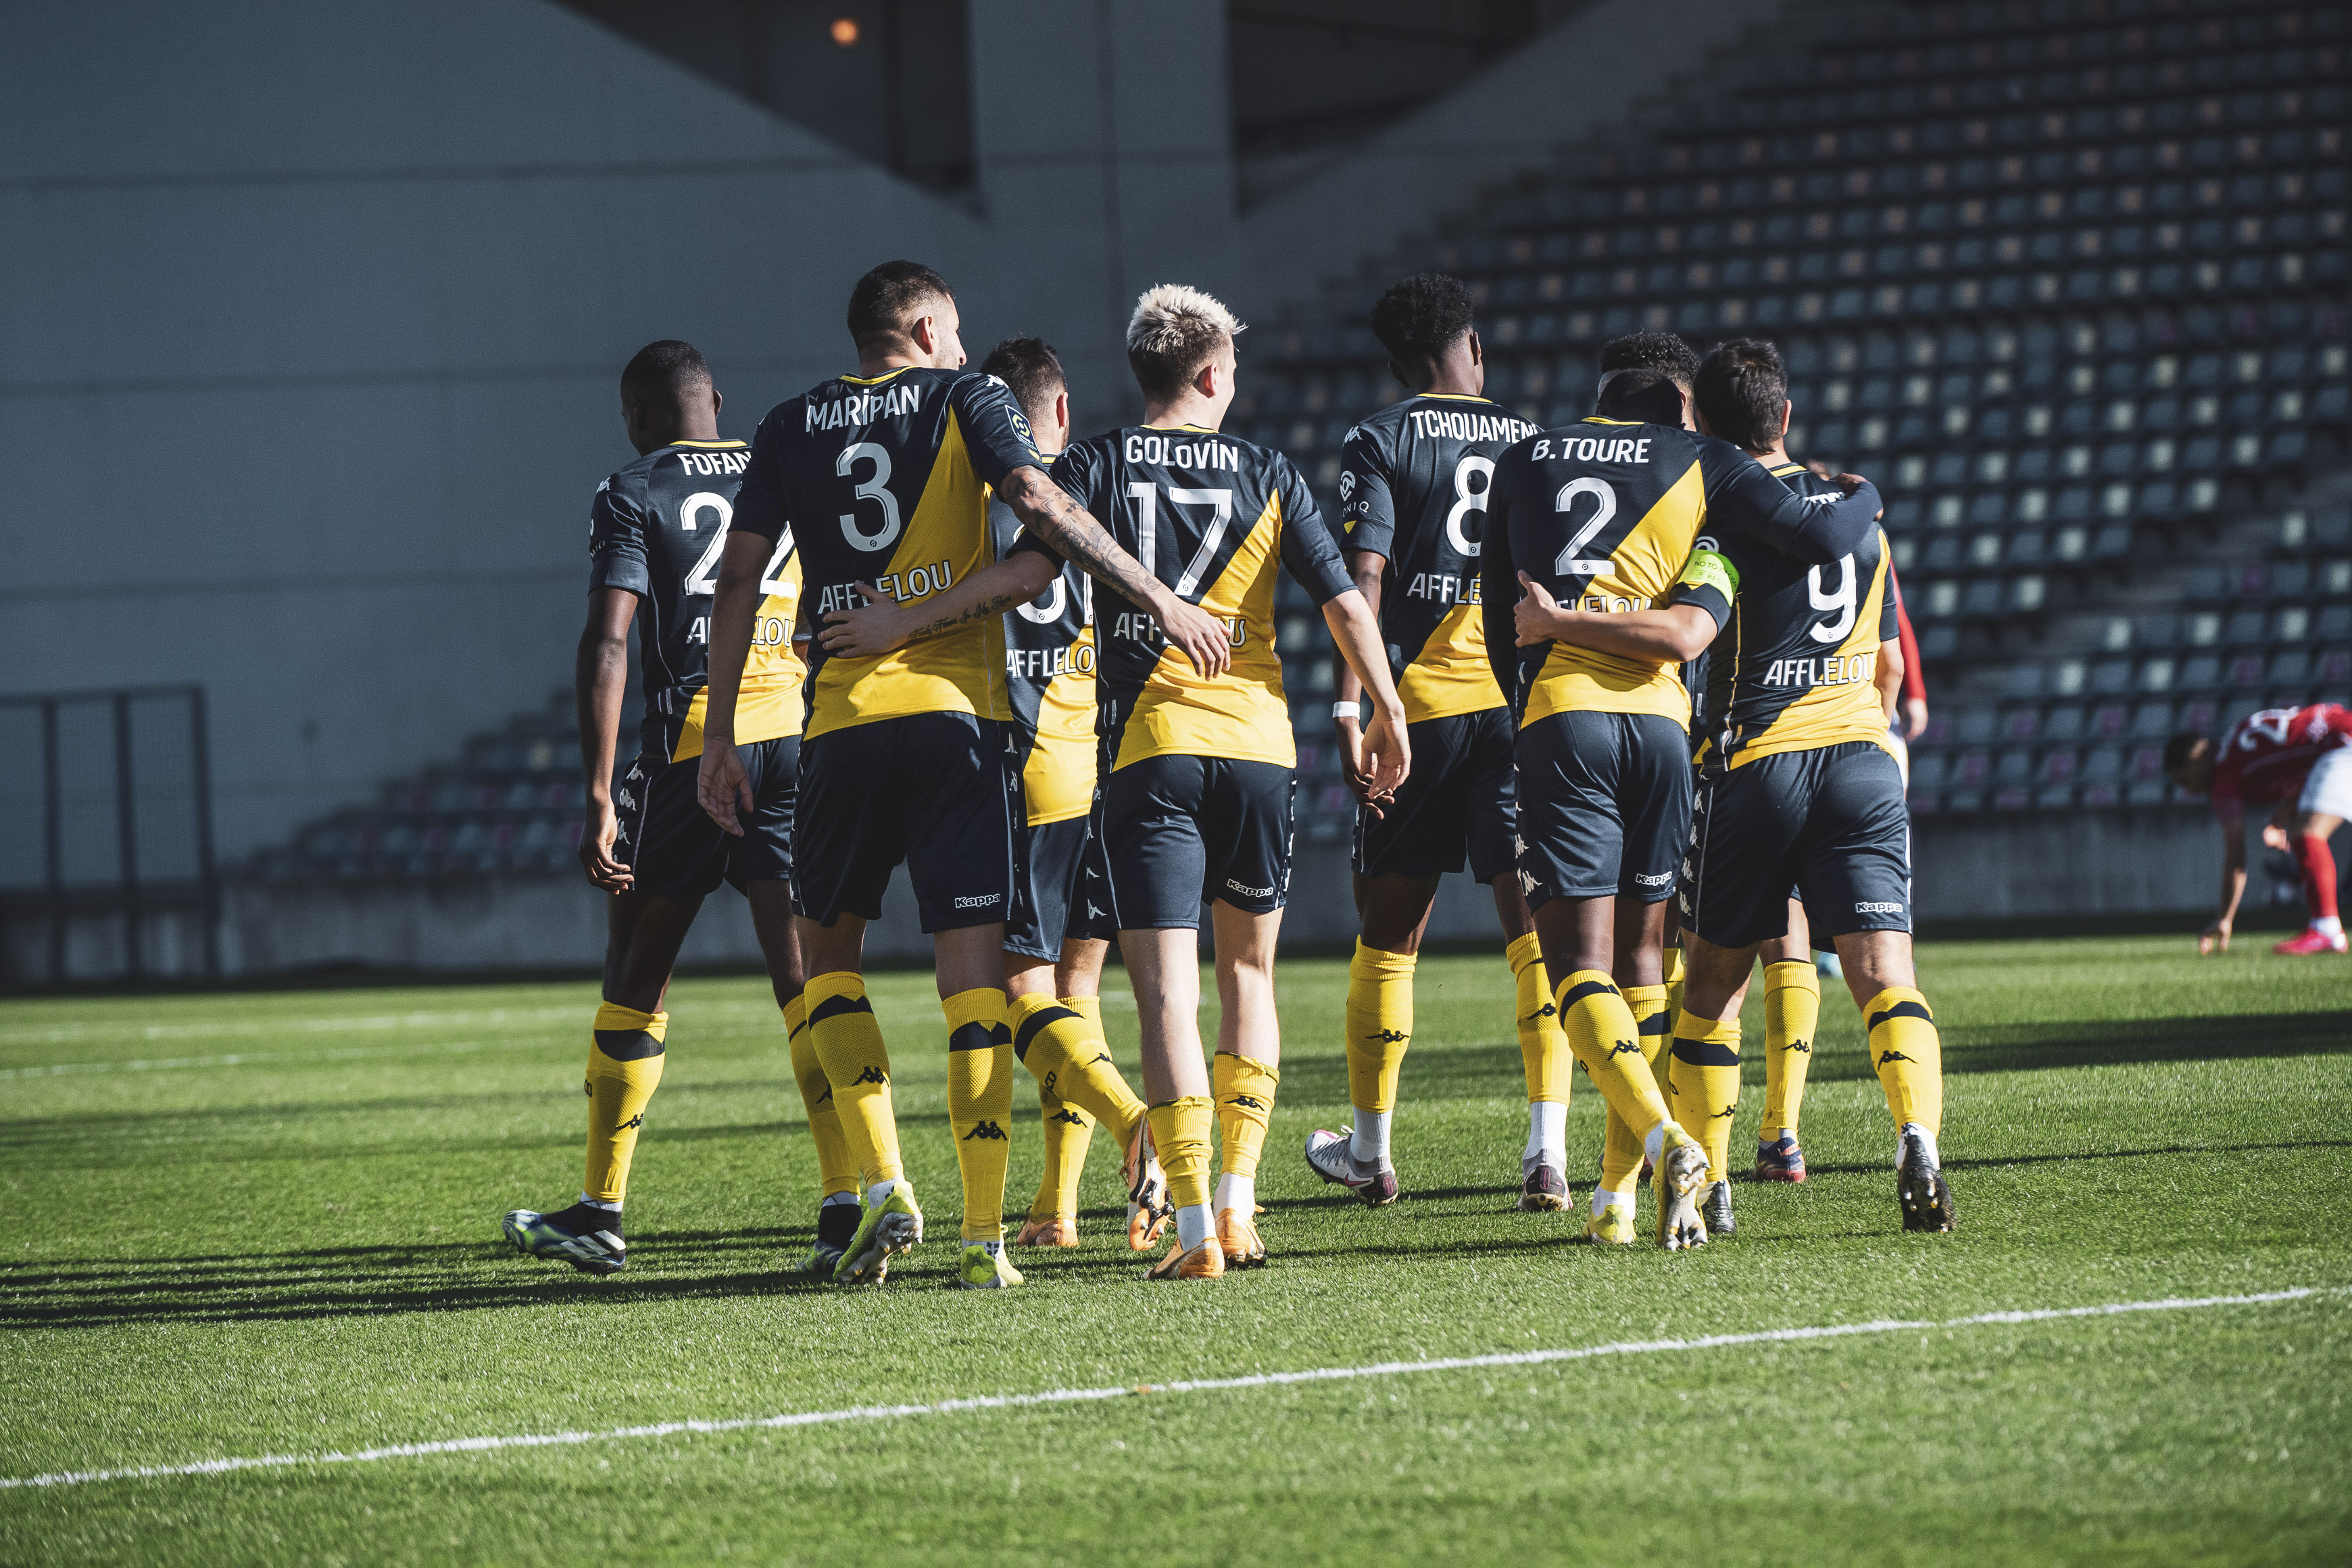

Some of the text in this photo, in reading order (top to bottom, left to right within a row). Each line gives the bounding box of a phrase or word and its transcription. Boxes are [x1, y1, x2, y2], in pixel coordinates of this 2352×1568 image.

[1125, 435, 1238, 472] GOLOVIN
[1562, 437, 1652, 464] TOURE
[835, 442, 901, 552] 3
[1446, 456, 1496, 557] 8
[1126, 482, 1233, 596] 17
[1555, 476, 1617, 576] 2
[1406, 572, 1482, 605] AFFLE
[1808, 552, 1857, 643] 9
[1763, 652, 1877, 687] AFFLELOU
[1227, 879, 1273, 898] Kappa
[1636, 871, 1673, 886] Kappa
[955, 893, 1000, 908] Kappa
[1855, 902, 1903, 913] Kappa
